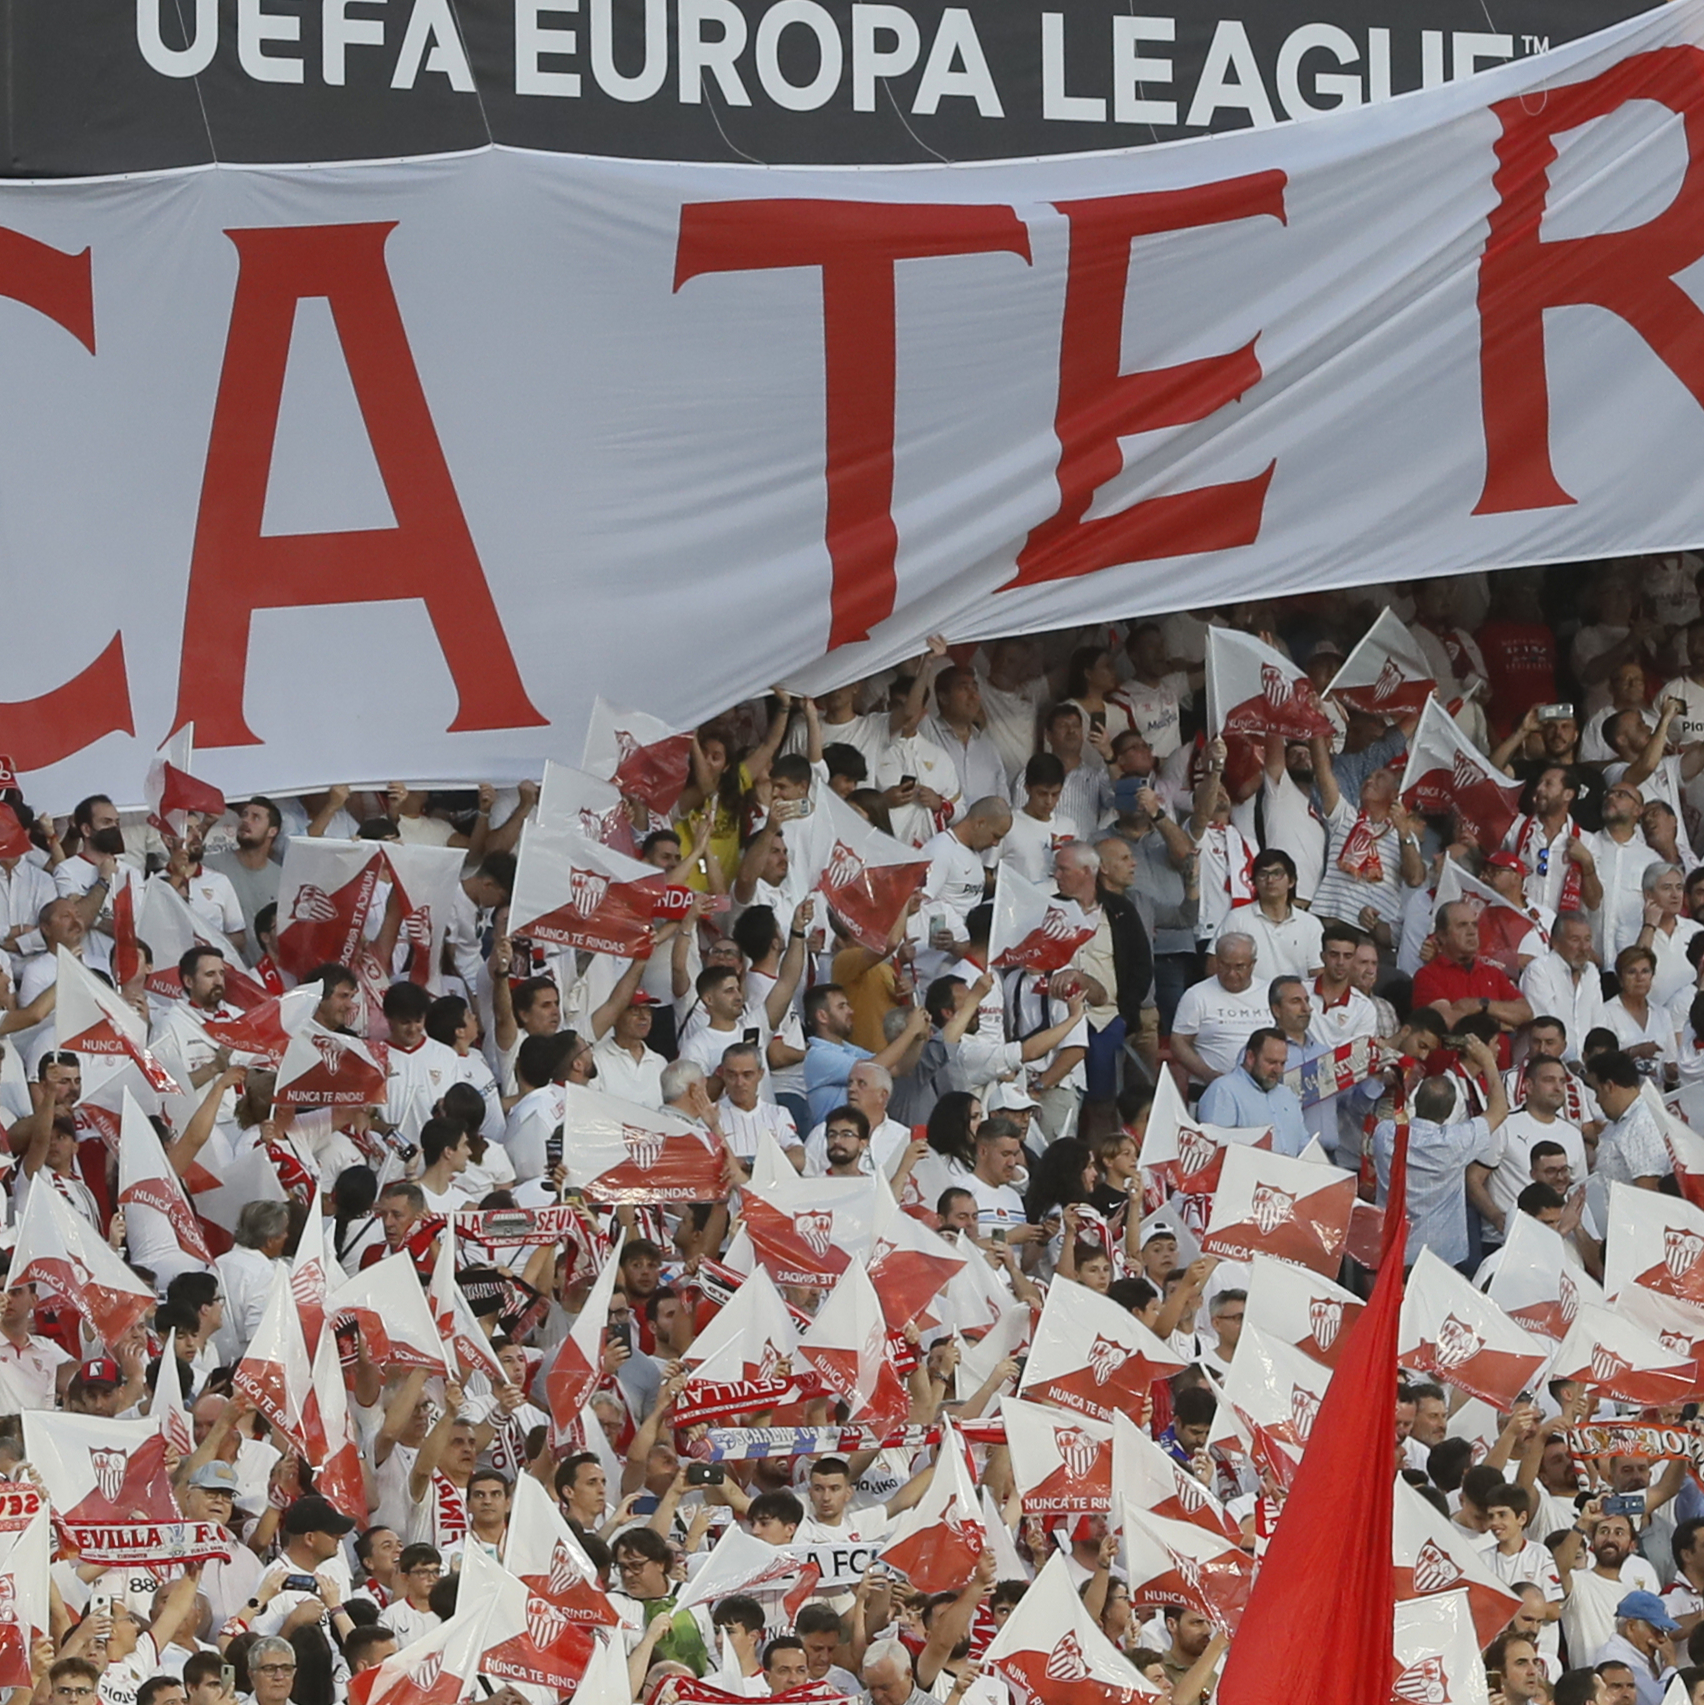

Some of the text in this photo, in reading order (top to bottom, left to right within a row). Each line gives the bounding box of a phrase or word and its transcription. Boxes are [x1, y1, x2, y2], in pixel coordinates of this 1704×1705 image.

[676, 170, 1286, 649] TE
[534, 925, 625, 955] NUNCA TE RINDAS
[82, 1038, 124, 1052] NUNCA
[286, 1089, 366, 1103] NUNCA TE RINDAS
[652, 1187, 697, 1199] RINDAS
[1208, 1238, 1248, 1259] NUNCA
[1048, 1386, 1081, 1408] NUNCA
[1024, 1497, 1087, 1511] NUNCA TE
[78, 1526, 161, 1550] EVILLA
[1144, 1590, 1187, 1605] NUNCA
[485, 1658, 543, 1682] NUNCA TE
